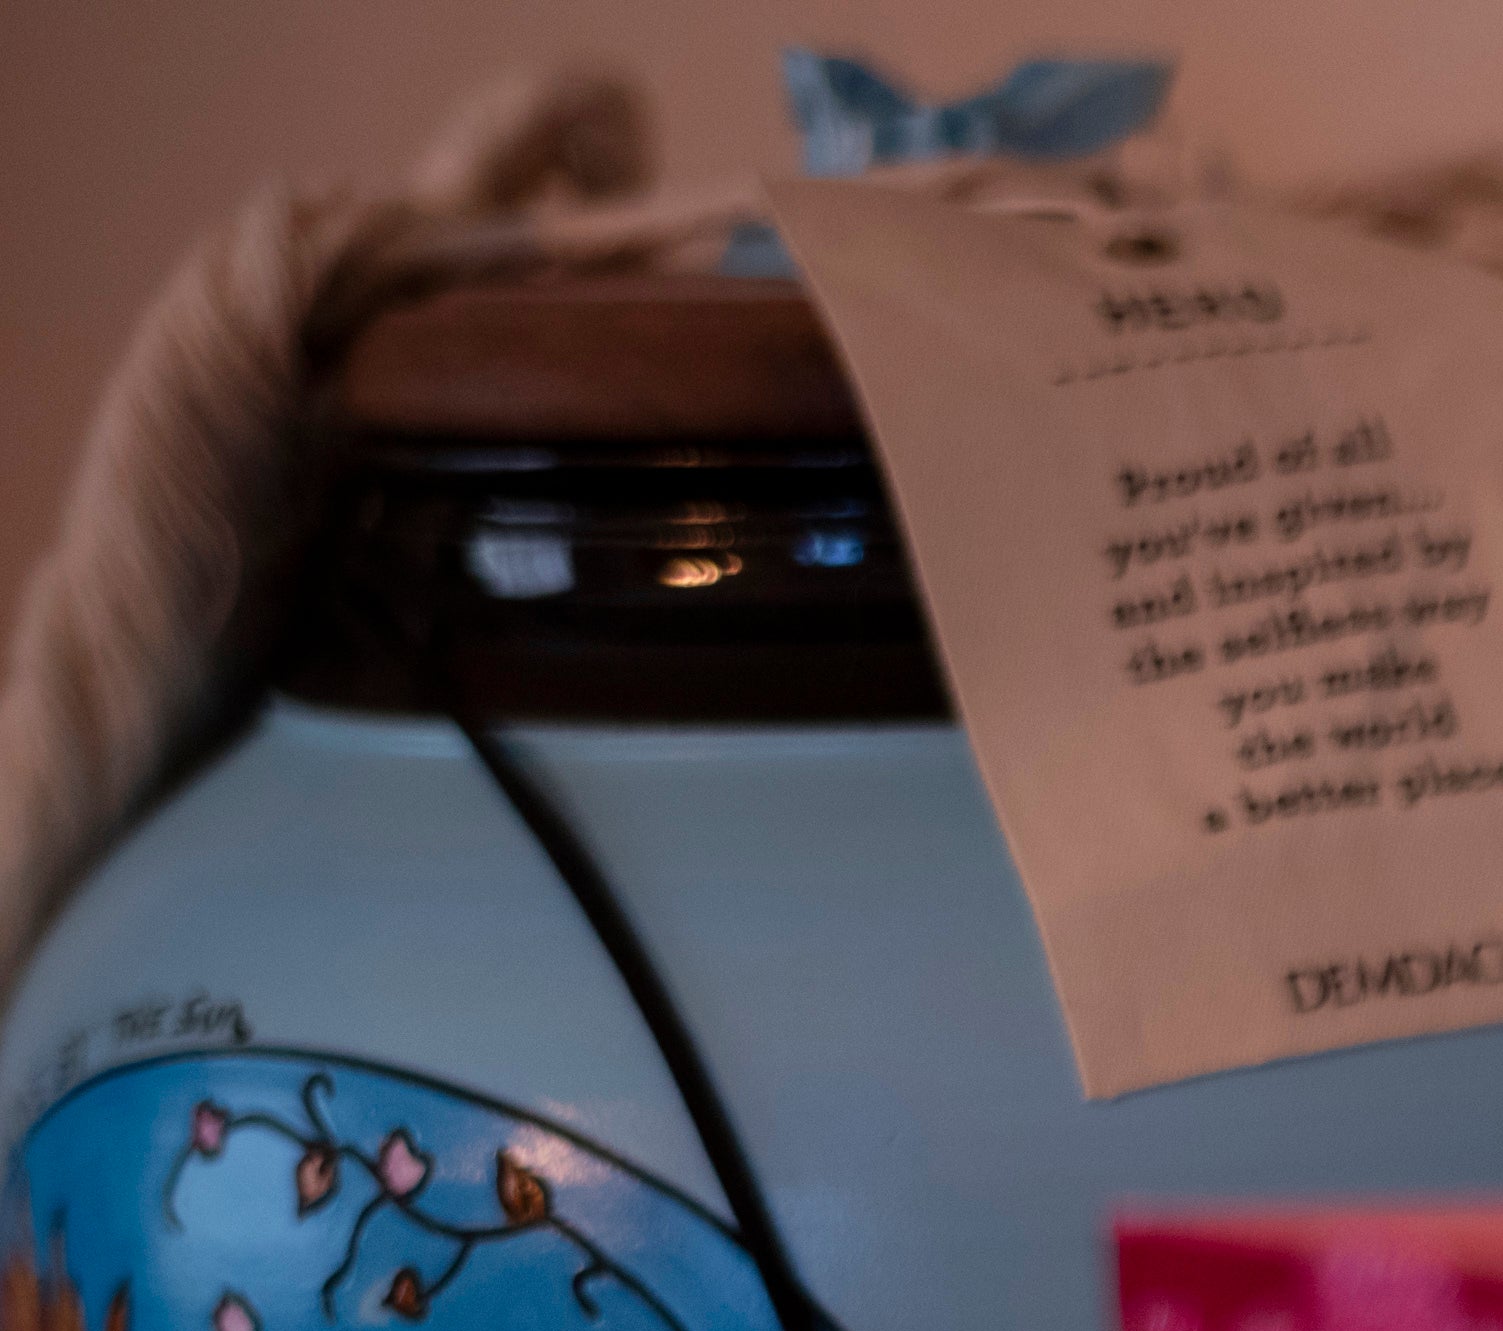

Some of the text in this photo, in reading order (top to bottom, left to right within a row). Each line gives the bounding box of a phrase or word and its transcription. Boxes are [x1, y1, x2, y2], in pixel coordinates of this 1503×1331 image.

[1117, 414, 1393, 508] Proud of all
[1105, 514, 1256, 580] you've
[1110, 523, 1473, 630] and inspired by
[1127, 590, 1493, 686] the selfless way
[1218, 646, 1438, 730] you make
[1236, 692, 1459, 772] the world
[1203, 808, 1230, 834] a
[1238, 782, 1381, 827] better
